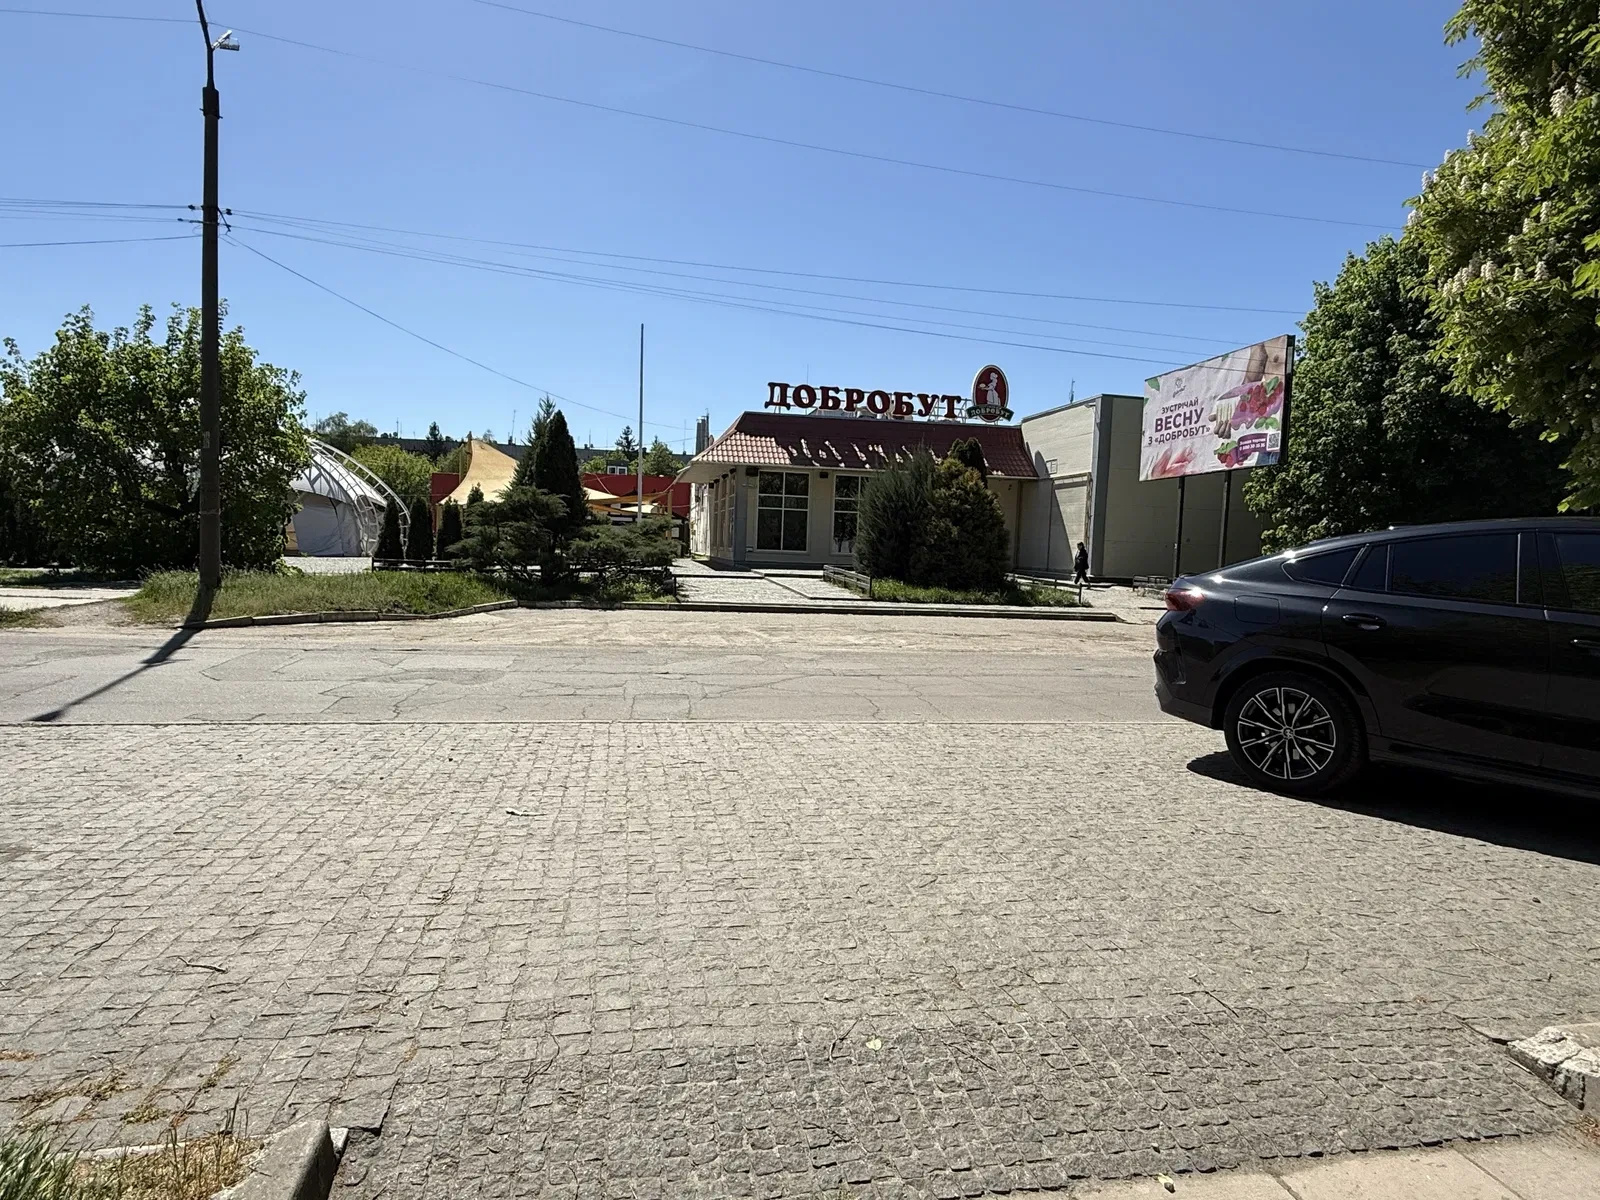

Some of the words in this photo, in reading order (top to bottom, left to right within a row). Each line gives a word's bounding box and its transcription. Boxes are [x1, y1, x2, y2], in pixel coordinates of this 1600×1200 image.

[764, 381, 962, 419] ДОБРОБУТ
[1161, 397, 1199, 415] ЗУСТРІЧАЙ
[970, 407, 1010, 418] ДОБРОБУТ
[1155, 407, 1204, 433] ВЕСНУ
[1154, 425, 1211, 445] «ДОБРОБУТ»
